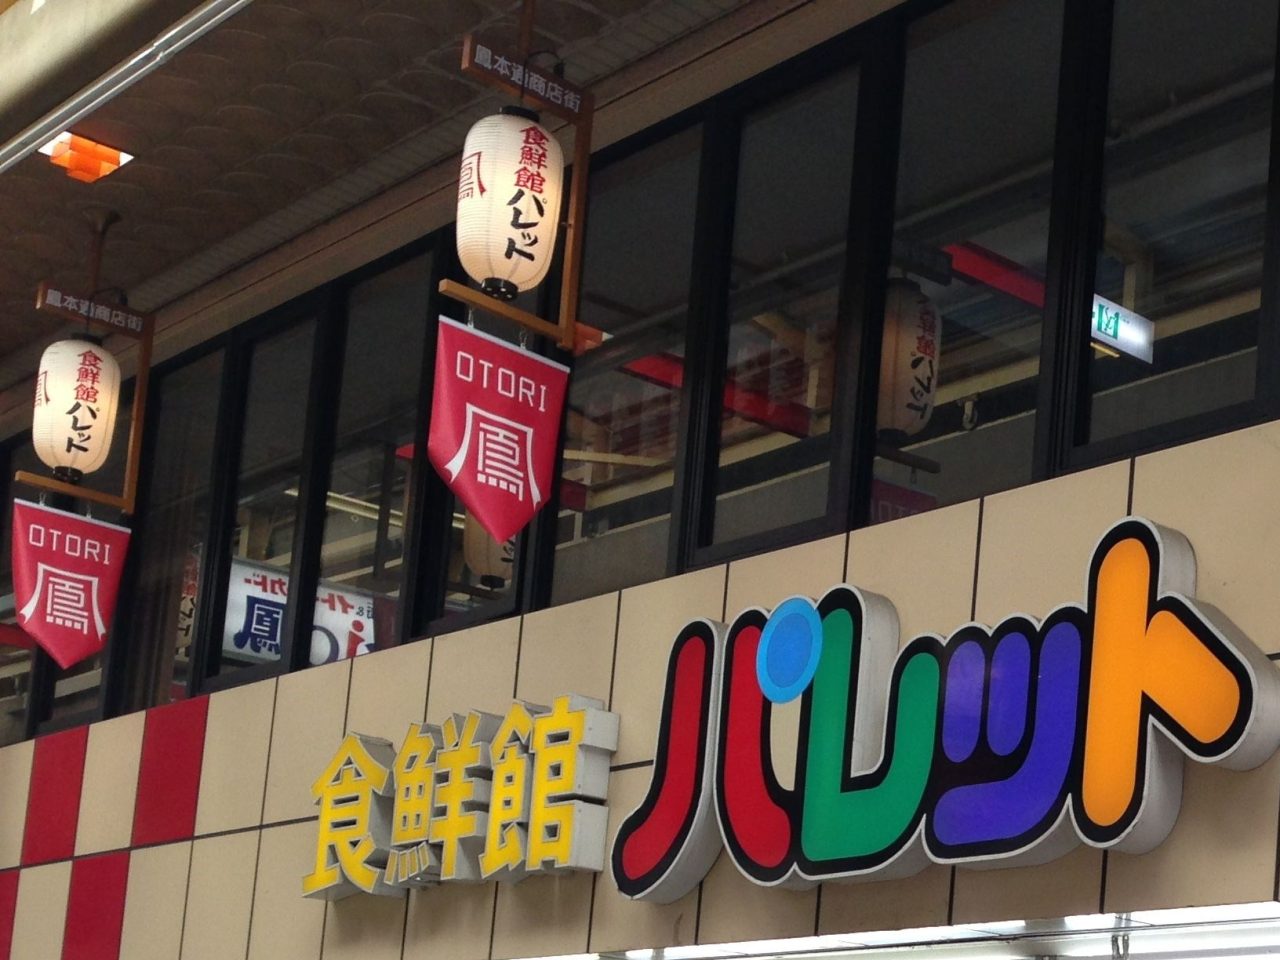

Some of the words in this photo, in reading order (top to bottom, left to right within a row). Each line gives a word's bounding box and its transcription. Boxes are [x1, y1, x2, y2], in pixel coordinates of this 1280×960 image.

[456, 351, 547, 413] OTORI
[29, 523, 111, 566] OTORI
[613, 518, 1275, 902] パレット
[302, 694, 592, 897] 食鮮館
